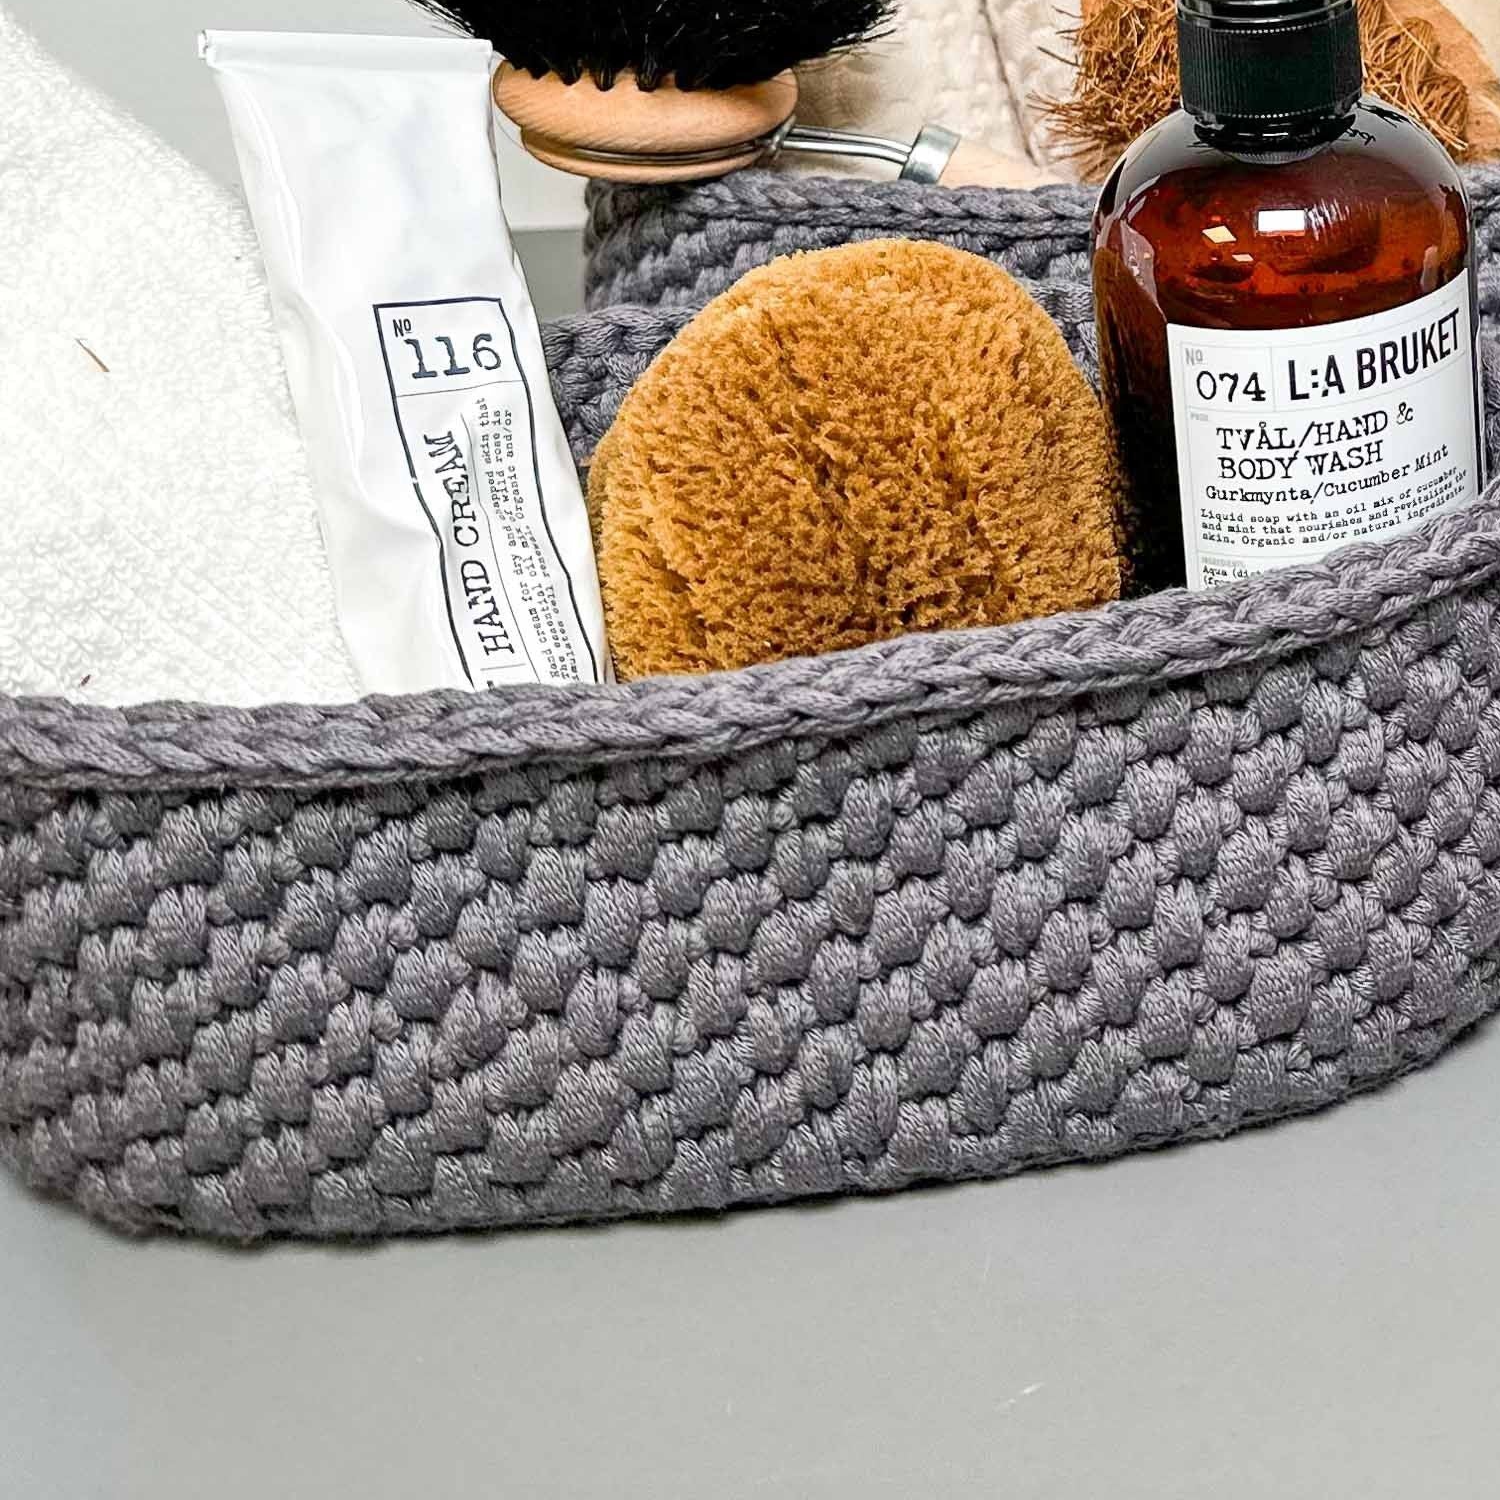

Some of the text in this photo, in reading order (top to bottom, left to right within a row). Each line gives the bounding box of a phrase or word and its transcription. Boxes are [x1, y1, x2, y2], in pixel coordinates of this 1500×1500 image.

[404, 333, 501, 379] 116
[1196, 307, 1459, 403] 074 L:A BRUKET
[475, 397, 490, 428] that
[493, 409, 515, 459] and/or
[1216, 401, 1414, 451] TVÅL/HAND &
[1206, 443, 1449, 505] Gurkmynta/Cucumber Mint
[1217, 439, 1384, 480] BODY WASH
[506, 465, 525, 522] Organic
[1200, 508, 1244, 522] Liquid
[1250, 515, 1280, 525] soap
[1286, 511, 1318, 522] with
[1324, 509, 1340, 518] an
[1345, 502, 1367, 515] oil
[1373, 497, 1395, 509] mix
[1399, 488, 1412, 500] of
[1201, 521, 1222, 531] and
[1227, 524, 1256, 533] mint
[1262, 524, 1292, 534] that
[1298, 516, 1363, 533] nourishes
[1368, 509, 1389, 522] and
[1455, 469, 1467, 483] the
[423, 430, 514, 656] HAND CREAM
[502, 525, 517, 547] and
[1202, 531, 1235, 545] skin.
[1241, 535, 1296, 548] Organic
[1302, 529, 1347, 544] and/or
[1353, 516, 1401, 536] natural
[511, 554, 524, 576] dry
[519, 555, 537, 578] oil
[519, 581, 533, 602] for
